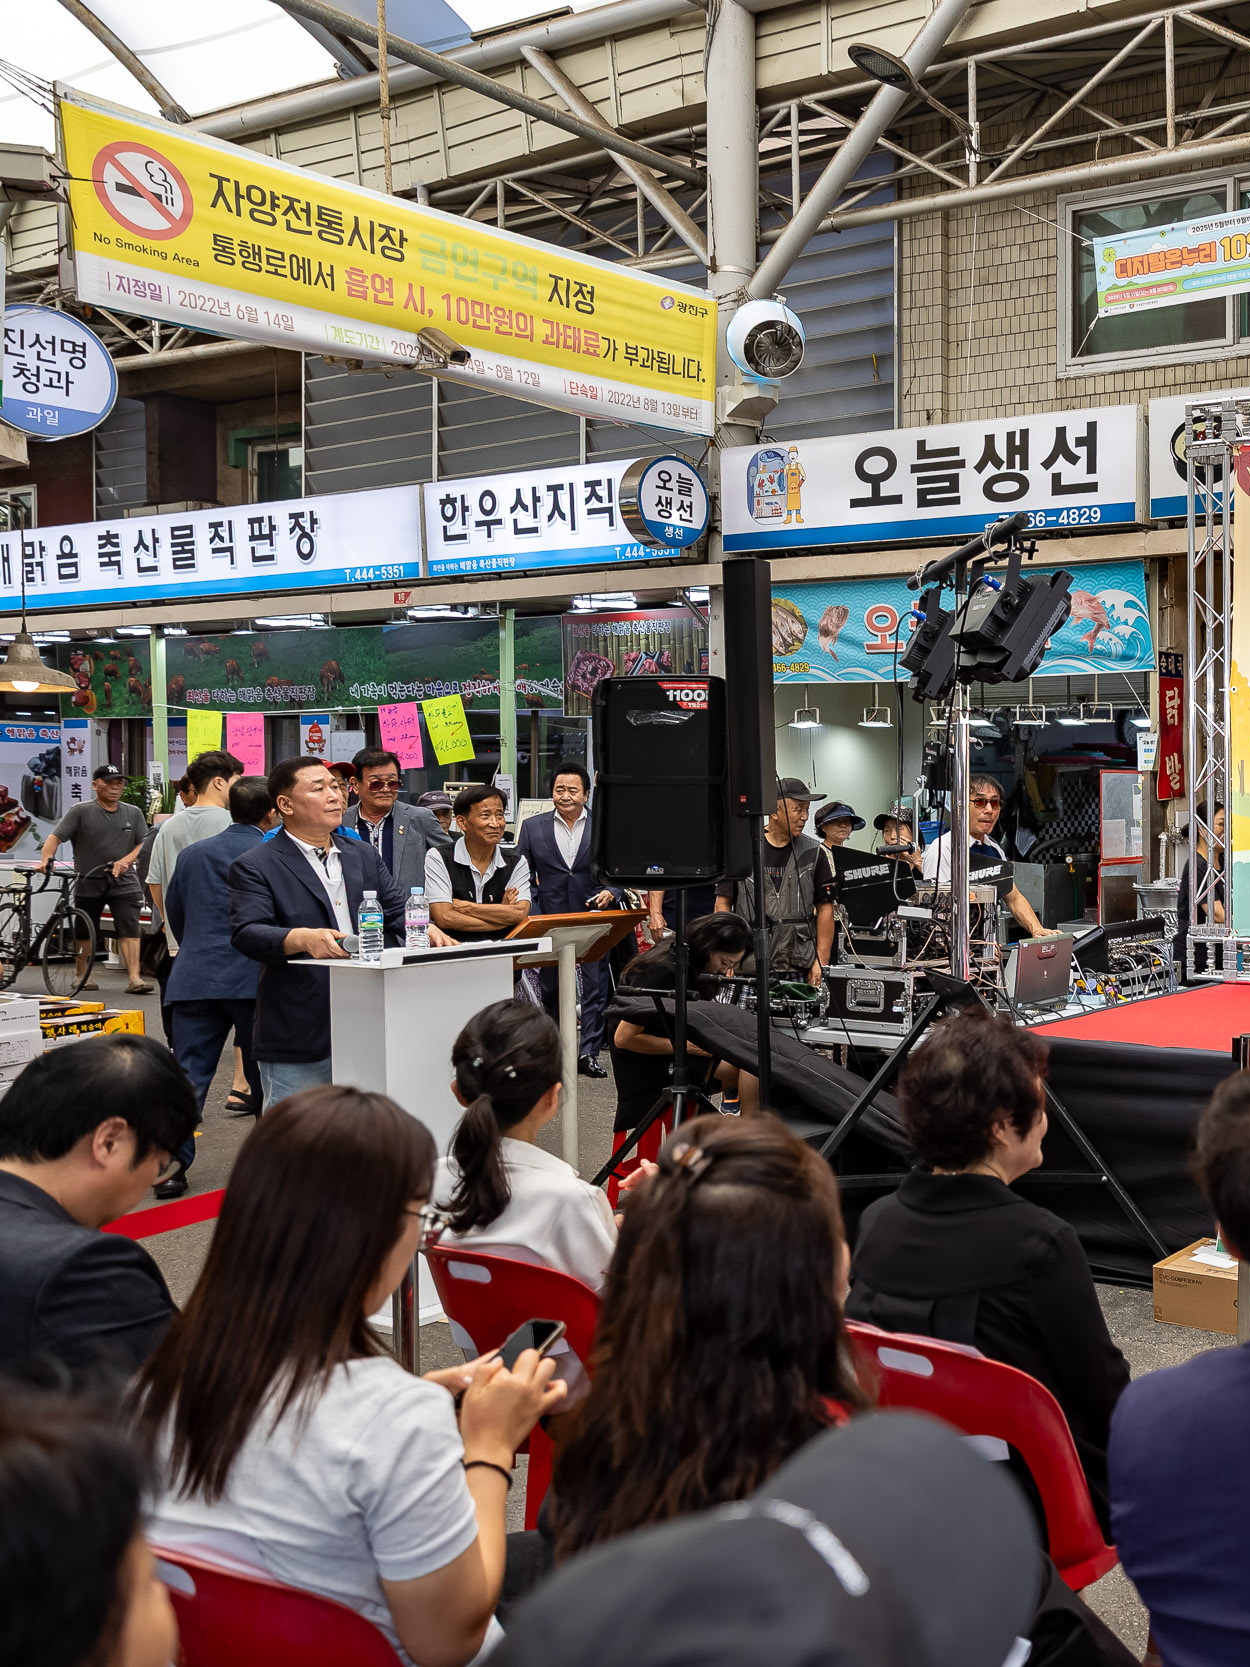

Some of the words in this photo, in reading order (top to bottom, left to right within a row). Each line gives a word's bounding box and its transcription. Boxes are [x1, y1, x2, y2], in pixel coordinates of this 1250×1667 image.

[93, 231, 111, 246] No
[115, 237, 168, 261] Smoking
[172, 251, 200, 268] Area
[208, 172, 408, 263] 자양전통시장
[417, 229, 539, 300] 금연구역
[548, 273, 596, 316] 지정
[1115, 242, 1217, 280] 디지털온누리
[177, 290, 232, 318] 2022년
[236, 304, 259, 323] 6월
[264, 310, 295, 333] 14일
[211, 232, 335, 291] 통행로에서
[344, 265, 395, 307] 흡연
[402, 281, 434, 319] 시,
[441, 293, 534, 343] 10만원의
[541, 319, 618, 362] 과태료가
[623, 342, 706, 383] 부과됩니다.
[677, 299, 709, 319] 광진구
[12, 361, 74, 397] 청과
[496, 362, 514, 383] 8월
[516, 368, 541, 388] 12일
[26, 406, 59, 426] 과일
[607, 389, 641, 410] 2022년
[643, 396, 659, 414] 8월
[661, 401, 699, 422] 13일부터
[849, 420, 1099, 509] 오늘생선
[655, 469, 694, 497] 오늘
[654, 495, 693, 523] 생선
[97, 510, 319, 577] 축산물직판장
[664, 525, 684, 539] 생선
[344, 565, 405, 582] T.444-5351
[632, 618, 671, 635] 축산물직판장
[1160, 654, 1183, 675] 순대국
[212, 687, 236, 703] 다하는
[264, 684, 316, 702] 축산물직판장
[350, 682, 360, 698] 내
[361, 681, 388, 700] 가족이
[387, 680, 424, 699] 먹는다는
[424, 679, 461, 697] 마음으로
[66, 765, 88, 778] 해맑음
[844, 864, 890, 881] SHURE
[81, 1022, 102, 1032] 복숭아
